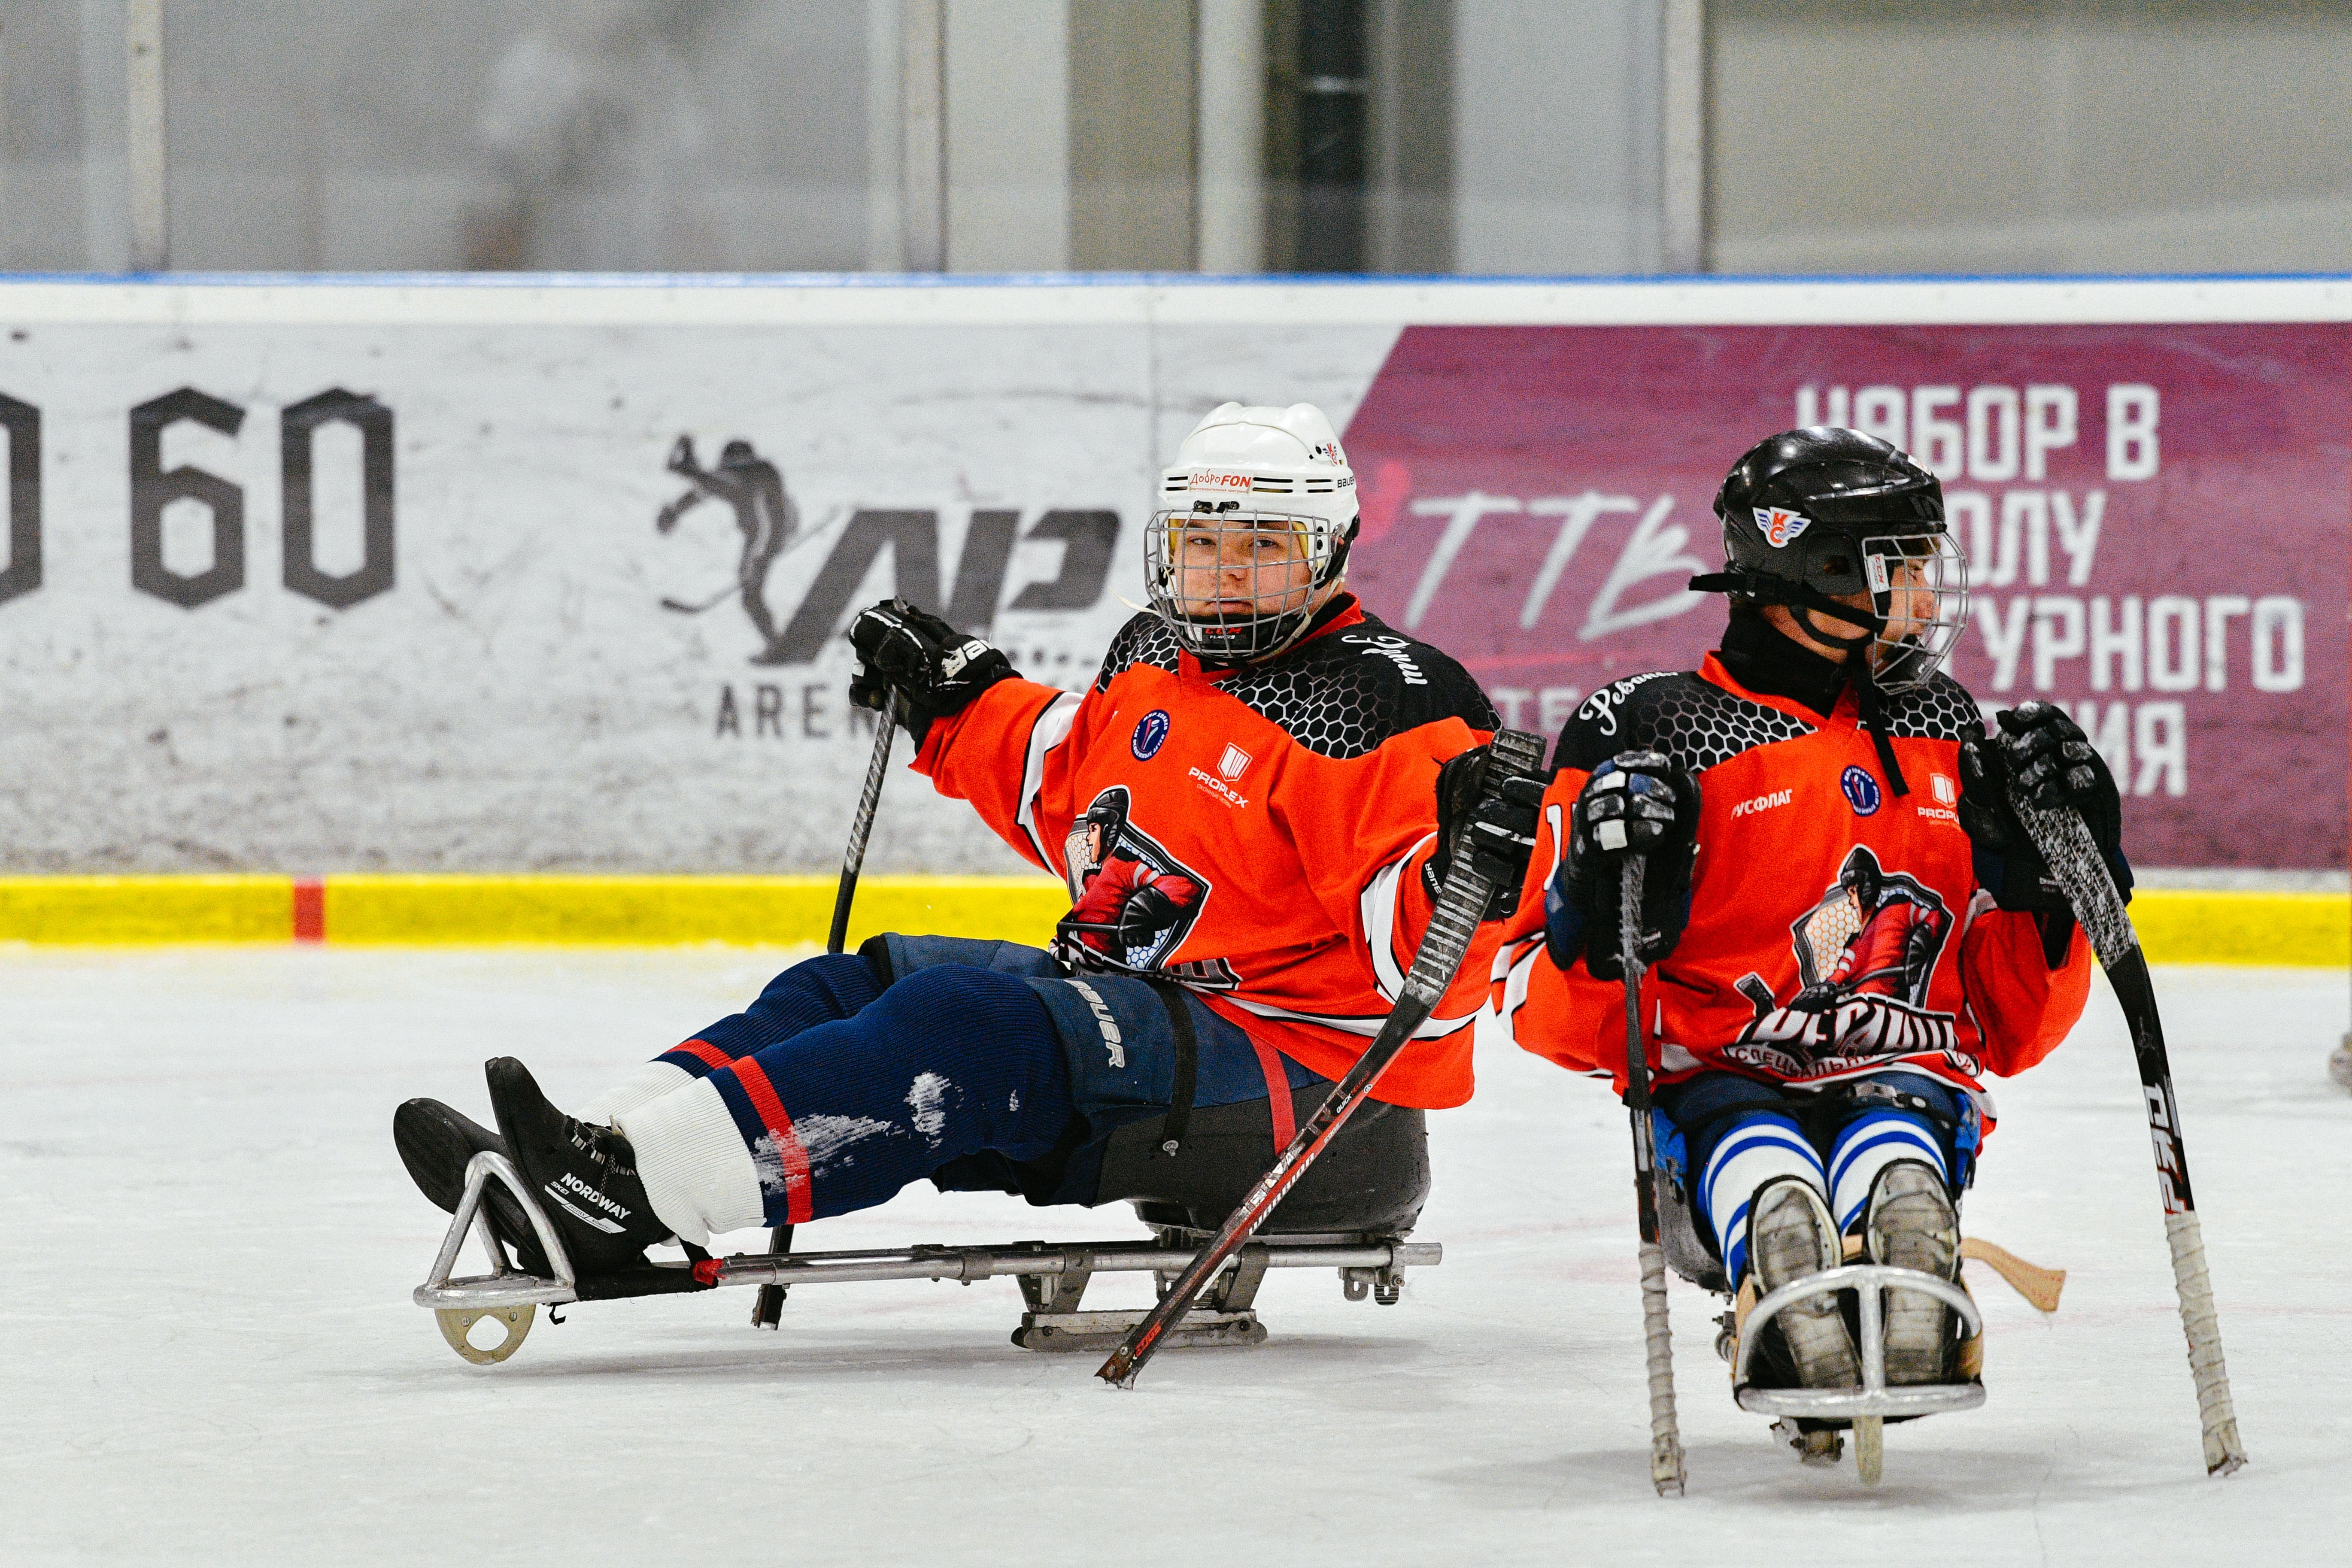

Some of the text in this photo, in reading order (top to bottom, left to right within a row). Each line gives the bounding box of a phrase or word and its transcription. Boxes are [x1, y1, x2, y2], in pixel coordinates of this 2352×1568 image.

[2106, 383, 2159, 482] В
[130, 387, 395, 611] 60
[1188, 766, 1249, 809] PROPLEX
[1334, 1092, 1353, 1114] QUICK
[551, 1181, 570, 1195] SKEI
[560, 1172, 631, 1219] NORDWAY
